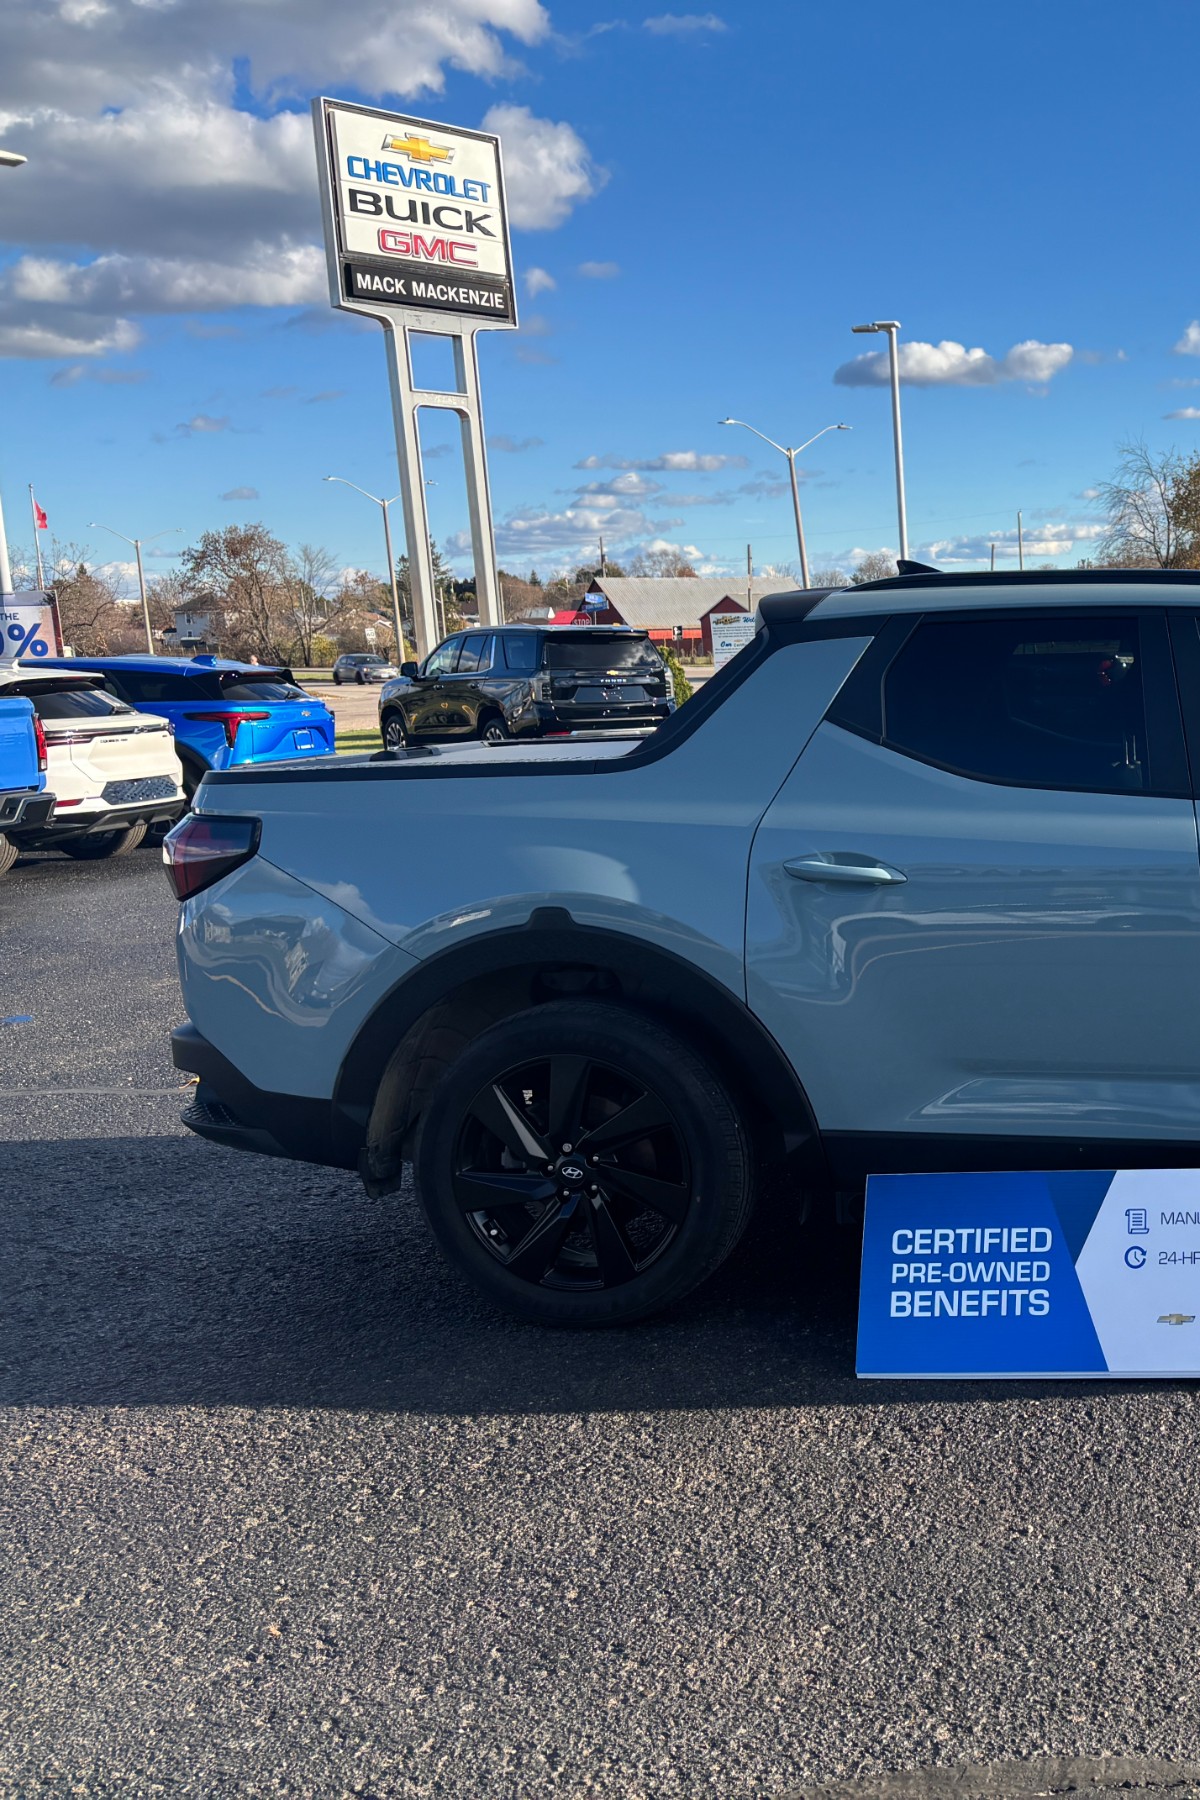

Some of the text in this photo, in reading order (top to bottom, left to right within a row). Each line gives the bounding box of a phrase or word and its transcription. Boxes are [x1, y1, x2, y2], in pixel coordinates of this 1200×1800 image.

[347, 155, 491, 203] CHEVROLET
[348, 188, 497, 237] BUICK
[378, 227, 478, 267] GMC
[356, 272, 505, 309] MACK MACKENZIE
[0, 612, 20, 621] THE
[891, 1227, 1053, 1256] CERTIFIED
[891, 1261, 1051, 1284] PRE-OWNED
[889, 1289, 1051, 1318] BENEFITS
